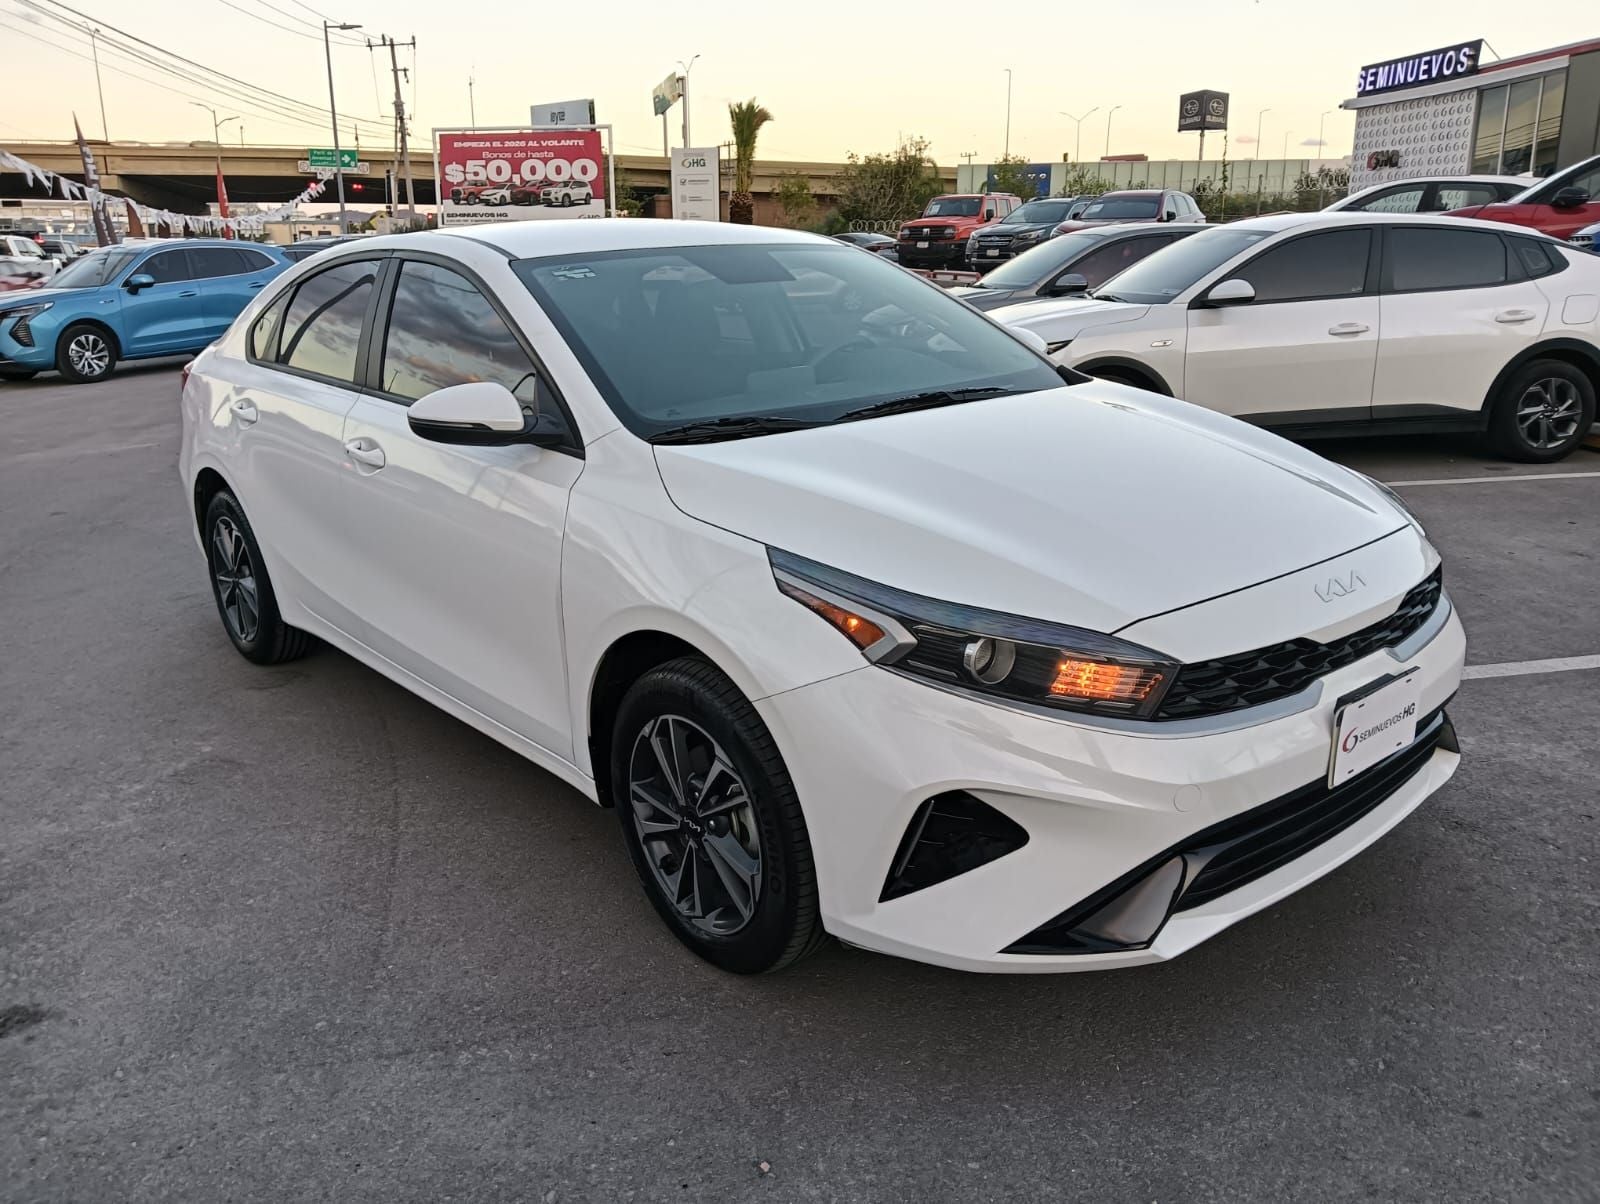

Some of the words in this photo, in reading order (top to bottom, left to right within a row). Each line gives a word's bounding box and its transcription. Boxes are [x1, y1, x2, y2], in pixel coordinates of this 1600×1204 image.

[1357, 47, 1470, 92] SEMINUEVOS
[482, 151, 512, 159] Bonos
[513, 150, 526, 158] de
[527, 150, 554, 158] hasta
[445, 158, 598, 185] $50,000
